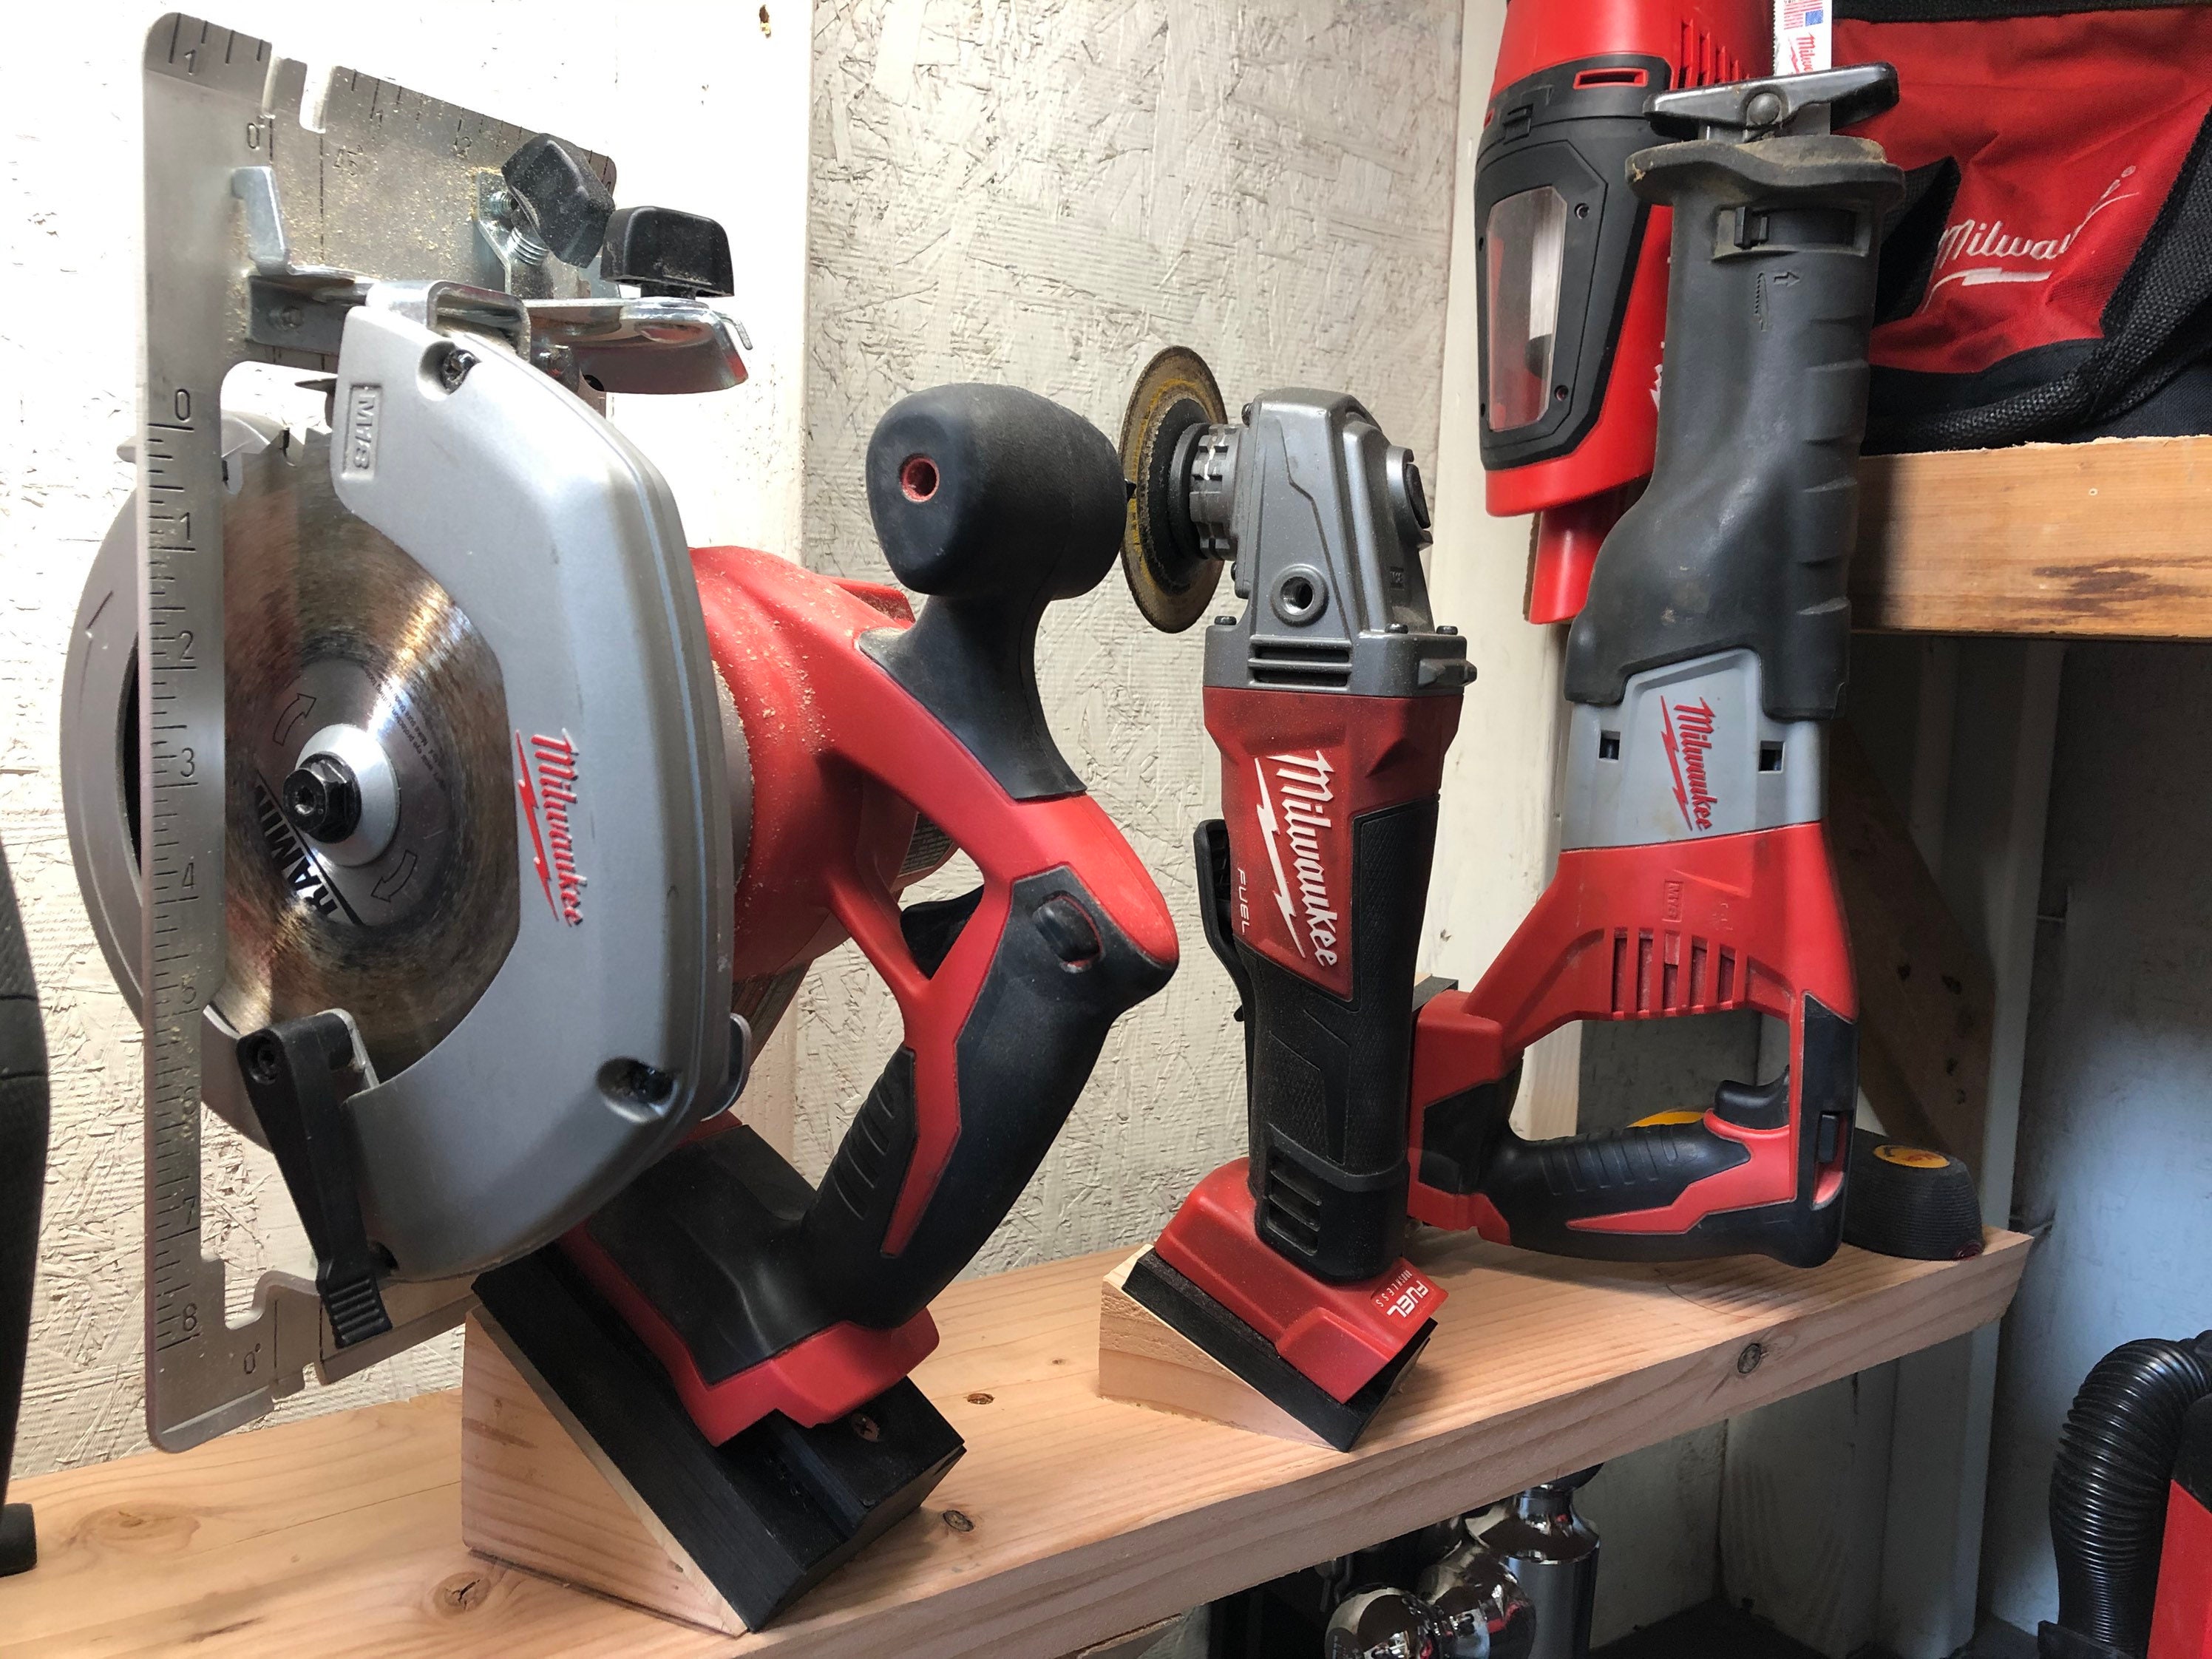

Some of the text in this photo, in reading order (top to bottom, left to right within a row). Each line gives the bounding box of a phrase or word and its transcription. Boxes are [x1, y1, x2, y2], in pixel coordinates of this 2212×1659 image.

[185, 49, 196, 75] 1
[174, 387, 191, 421] 0
[180, 512, 191, 542] 1
[179, 630, 195, 660] 2
[180, 747, 195, 778] 3
[1673, 696, 1718, 831] Milwaukee
[530, 727, 588, 928] Milwaukee
[1265, 749, 1339, 967] Milwaukee
[182, 862, 195, 889] 4
[1237, 867, 1250, 935] FUEL
[183, 1195, 197, 1225] 7
[1386, 1280, 1429, 1318] FUEL
[183, 1302, 197, 1331] 8
